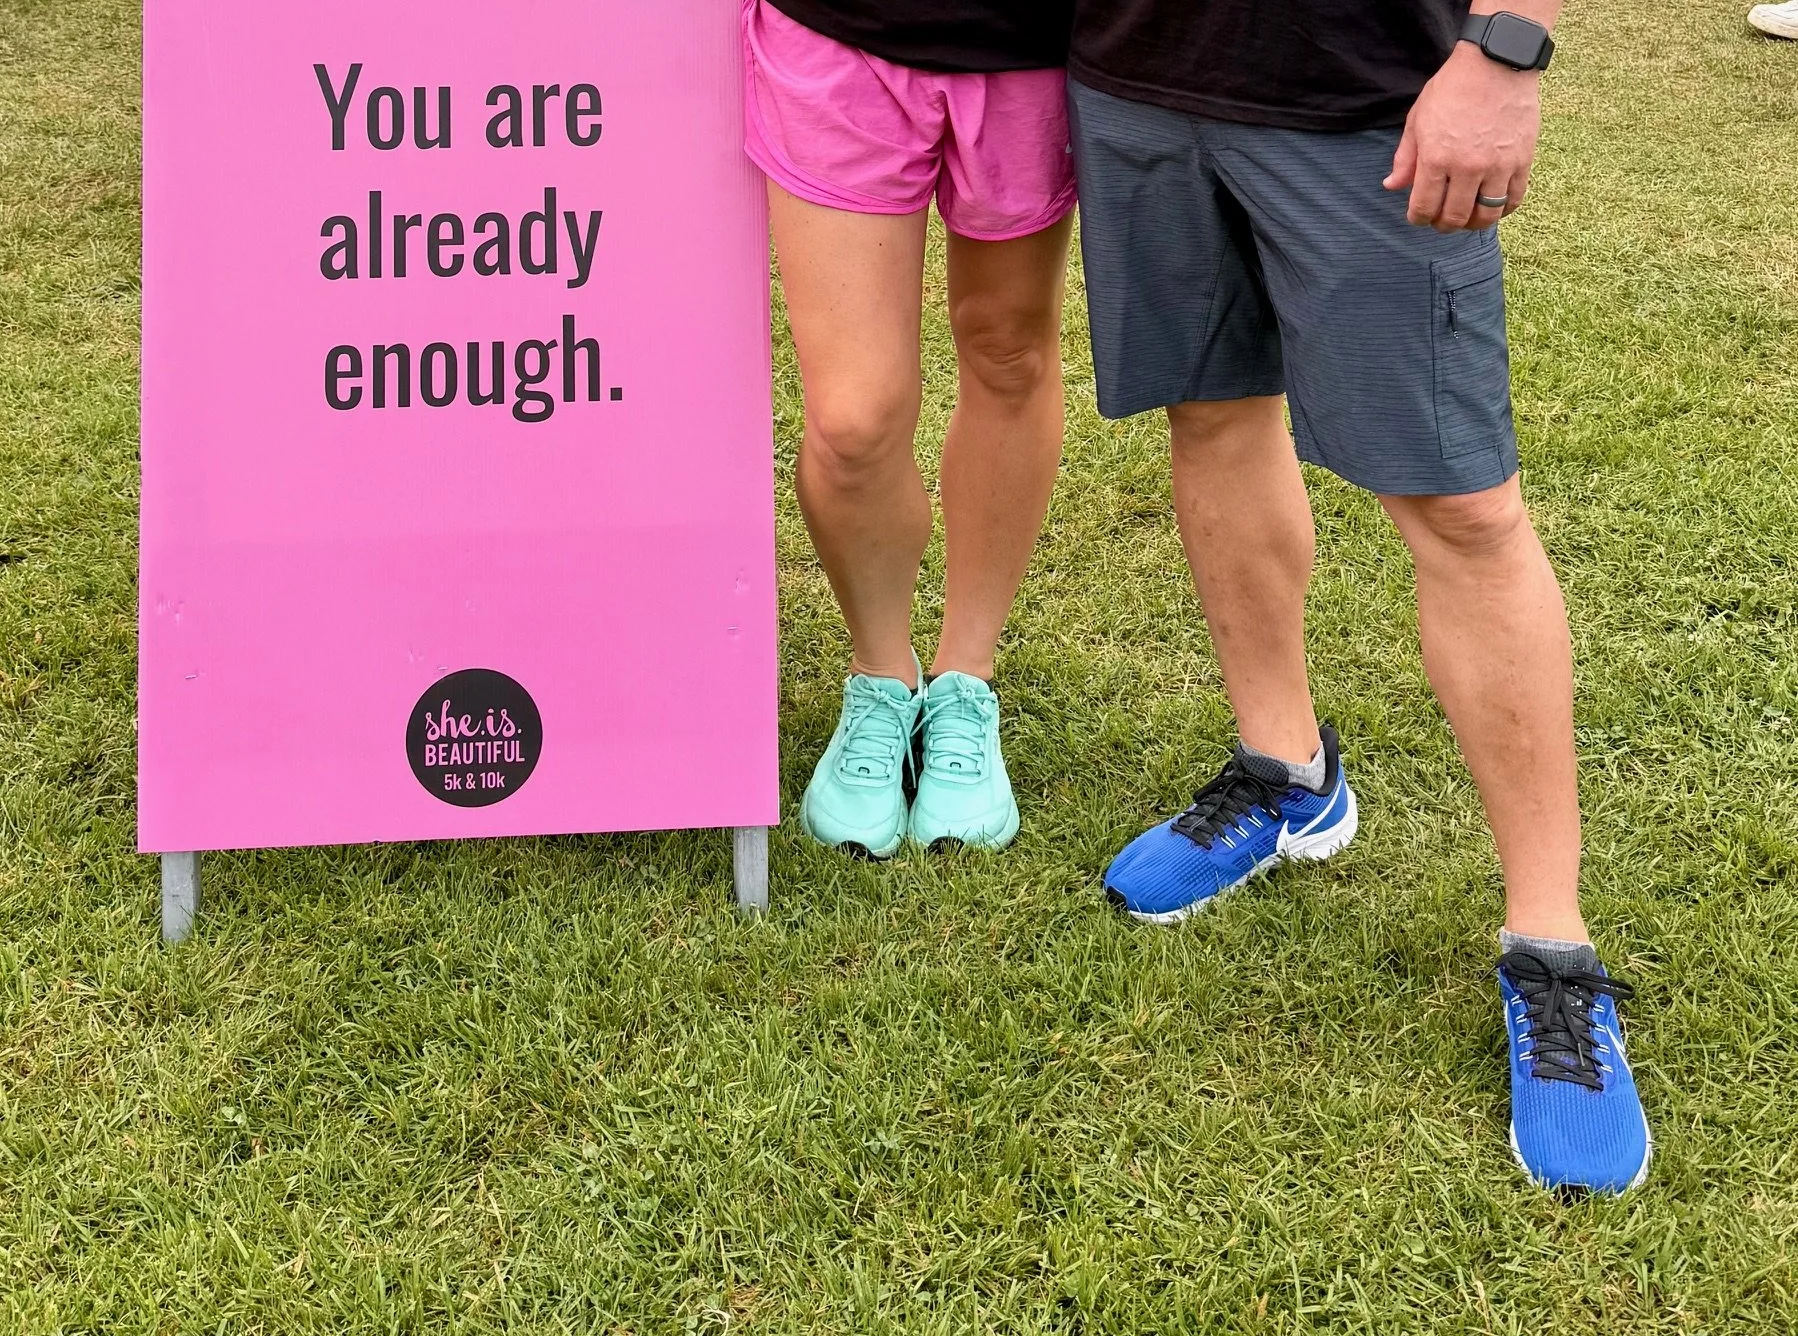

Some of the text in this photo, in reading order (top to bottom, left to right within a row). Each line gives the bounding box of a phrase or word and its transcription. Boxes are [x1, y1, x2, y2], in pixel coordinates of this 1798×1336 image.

[312, 62, 603, 151] You are
[319, 186, 604, 289] already
[323, 314, 624, 424] enough.
[424, 740, 526, 768] BEAUTIFUL
[444, 771, 505, 791] 5k & 10k
